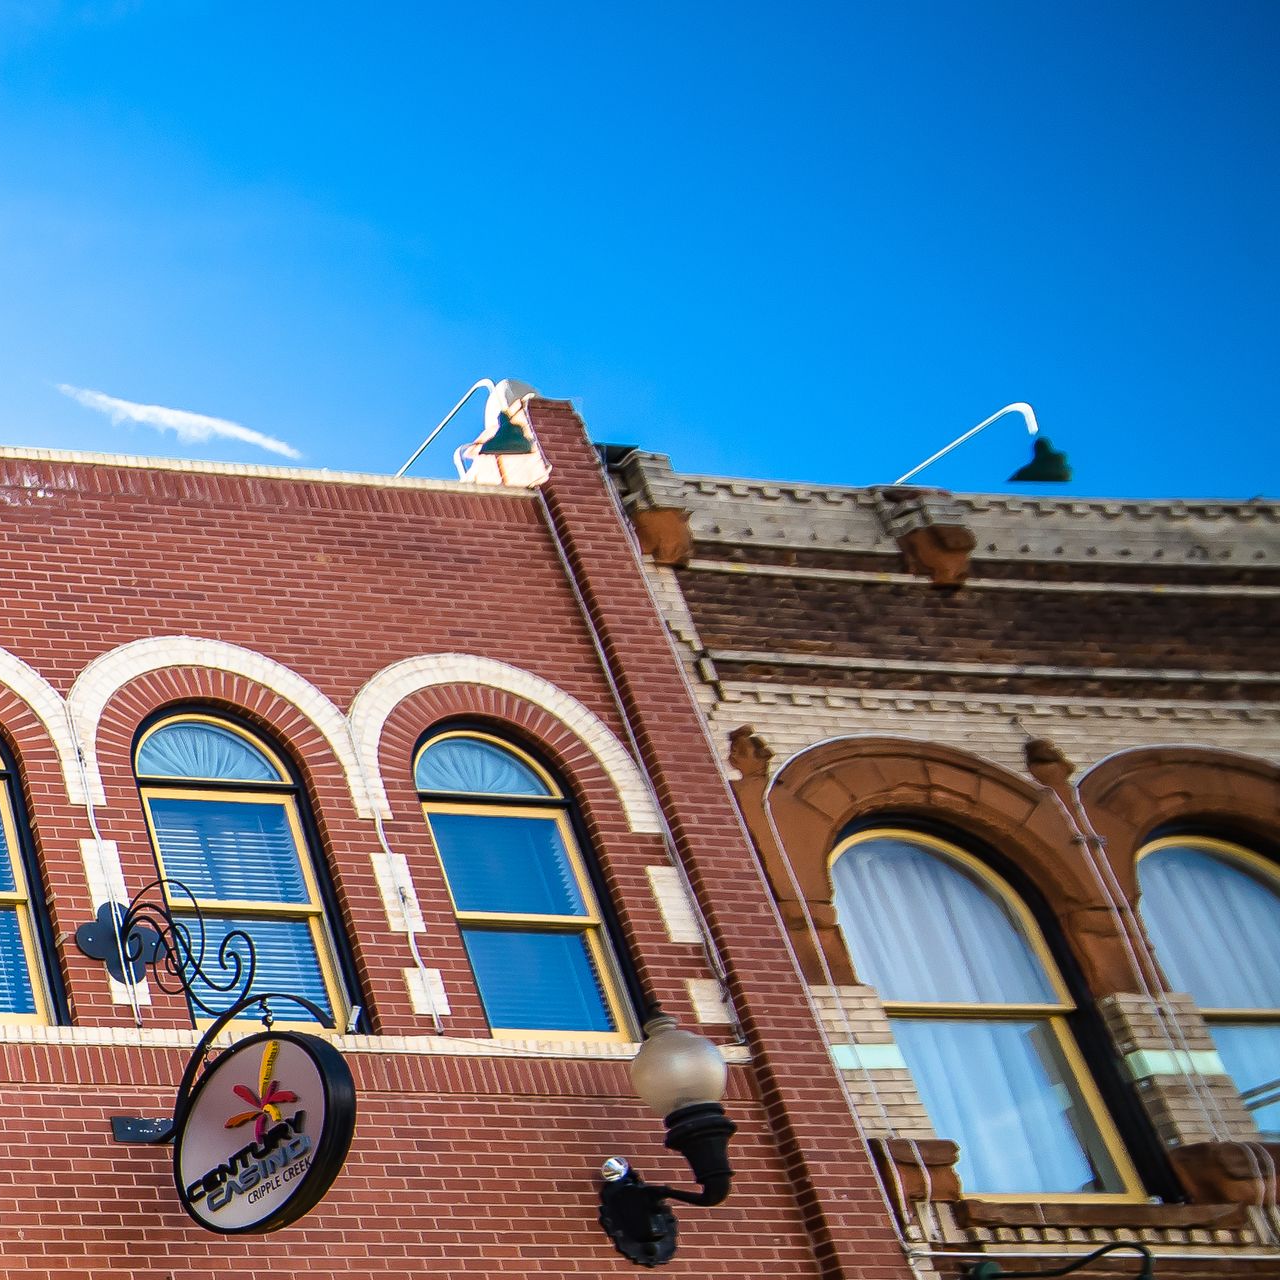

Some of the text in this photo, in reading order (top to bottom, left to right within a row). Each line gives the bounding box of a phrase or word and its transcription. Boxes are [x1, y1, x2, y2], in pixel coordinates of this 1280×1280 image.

[186, 1109, 307, 1203] CENTURY
[206, 1135, 311, 1213] CASINO
[247, 1155, 313, 1205] CRIPPLE CREEK
